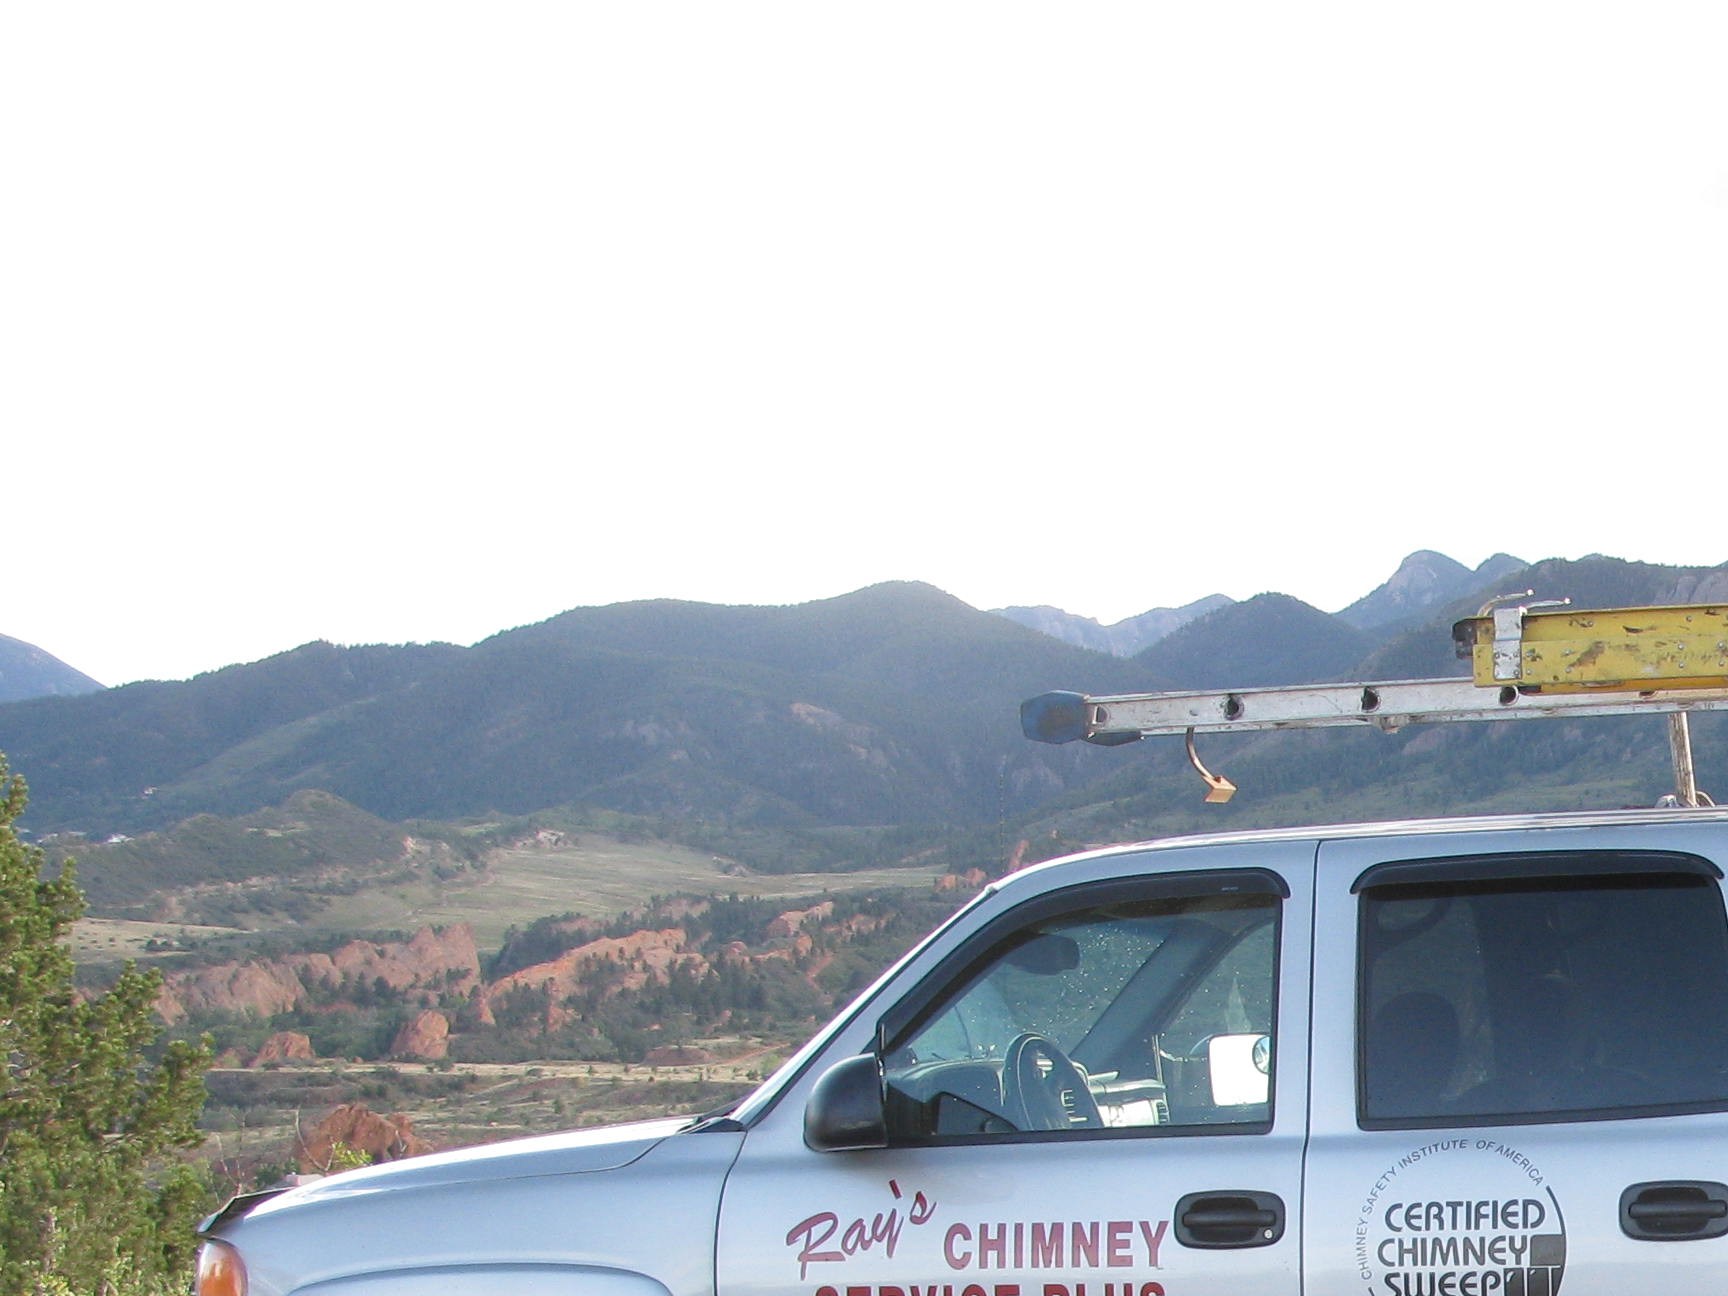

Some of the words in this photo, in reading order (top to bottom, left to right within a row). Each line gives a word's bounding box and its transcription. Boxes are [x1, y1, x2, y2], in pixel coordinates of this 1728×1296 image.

[1398, 1138, 1469, 1170] INSTITUTE
[1475, 1139, 1496, 1150] OF
[1496, 1145, 1544, 1186] AMERICA
[1362, 1166, 1398, 1215] SAFETY
[786, 1179, 937, 1281] Ray's
[1384, 1198, 1547, 1233] CERTIFIED
[943, 1219, 1170, 1270] CHIMNEY
[1355, 1219, 1372, 1280] CHIMNEY
[1377, 1234, 1528, 1267] CHIMNEY
